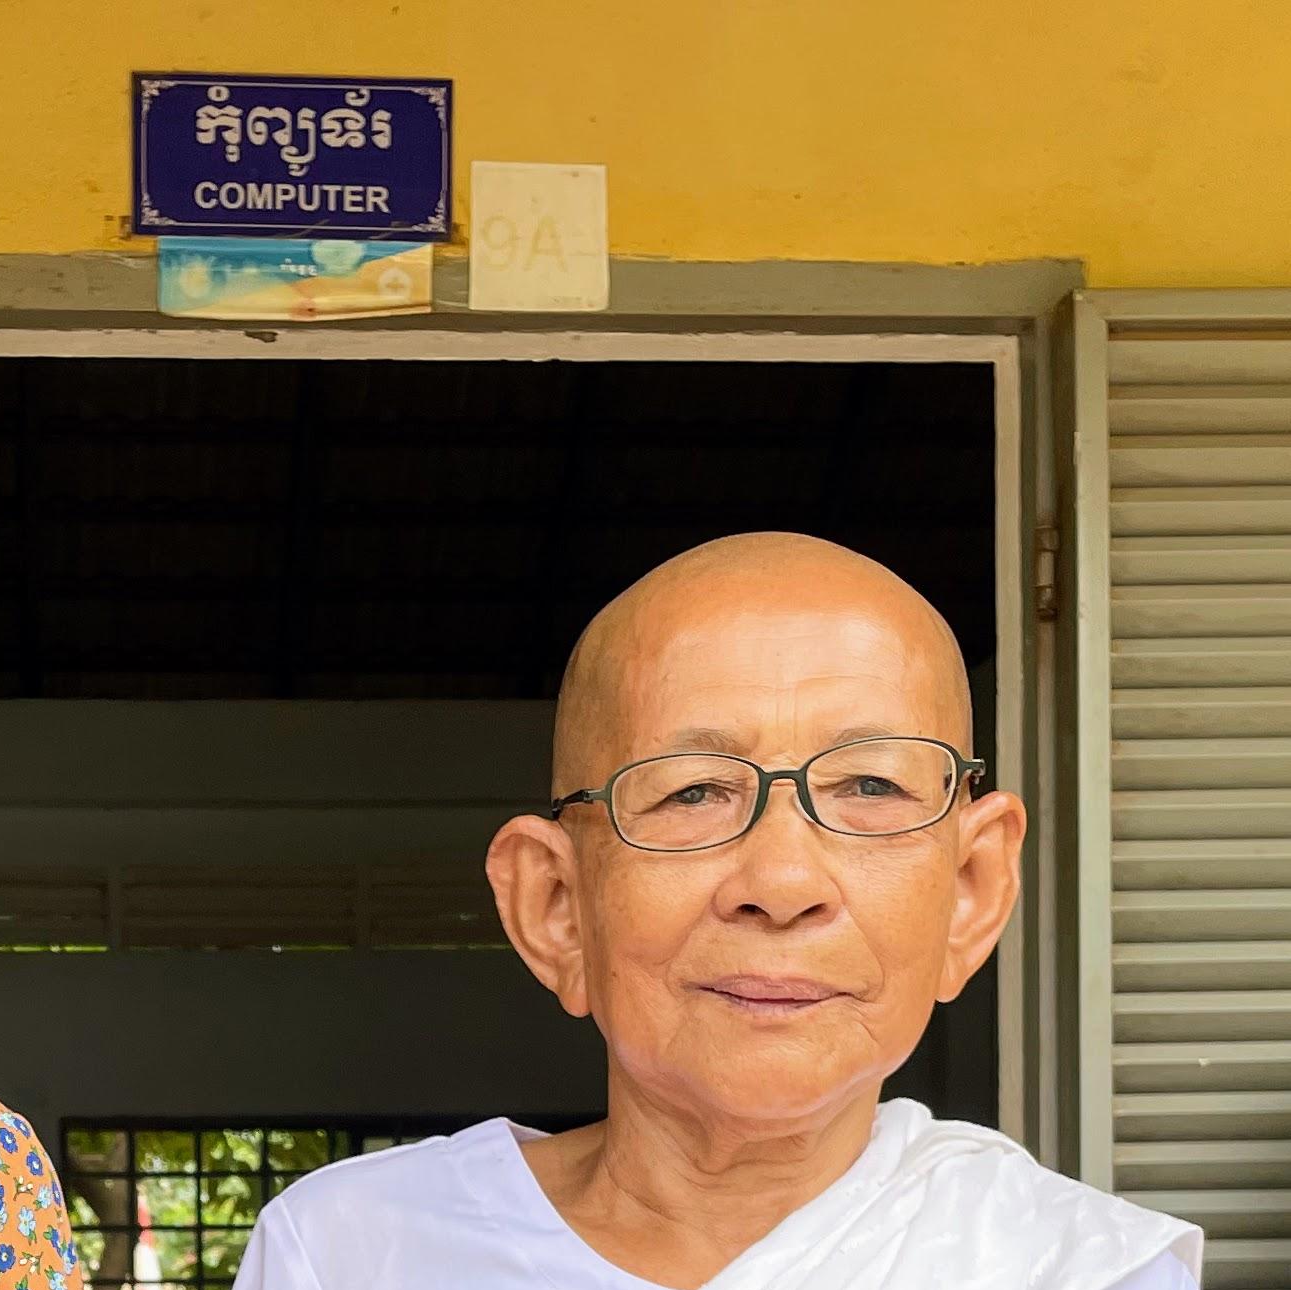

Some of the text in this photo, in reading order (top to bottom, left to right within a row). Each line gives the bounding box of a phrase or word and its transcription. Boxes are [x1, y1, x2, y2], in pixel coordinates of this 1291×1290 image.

[195, 85, 393, 177] កុំព្យូទ័រ
[194, 181, 391, 214] COMPUTER
[479, 213, 569, 273] 9A
